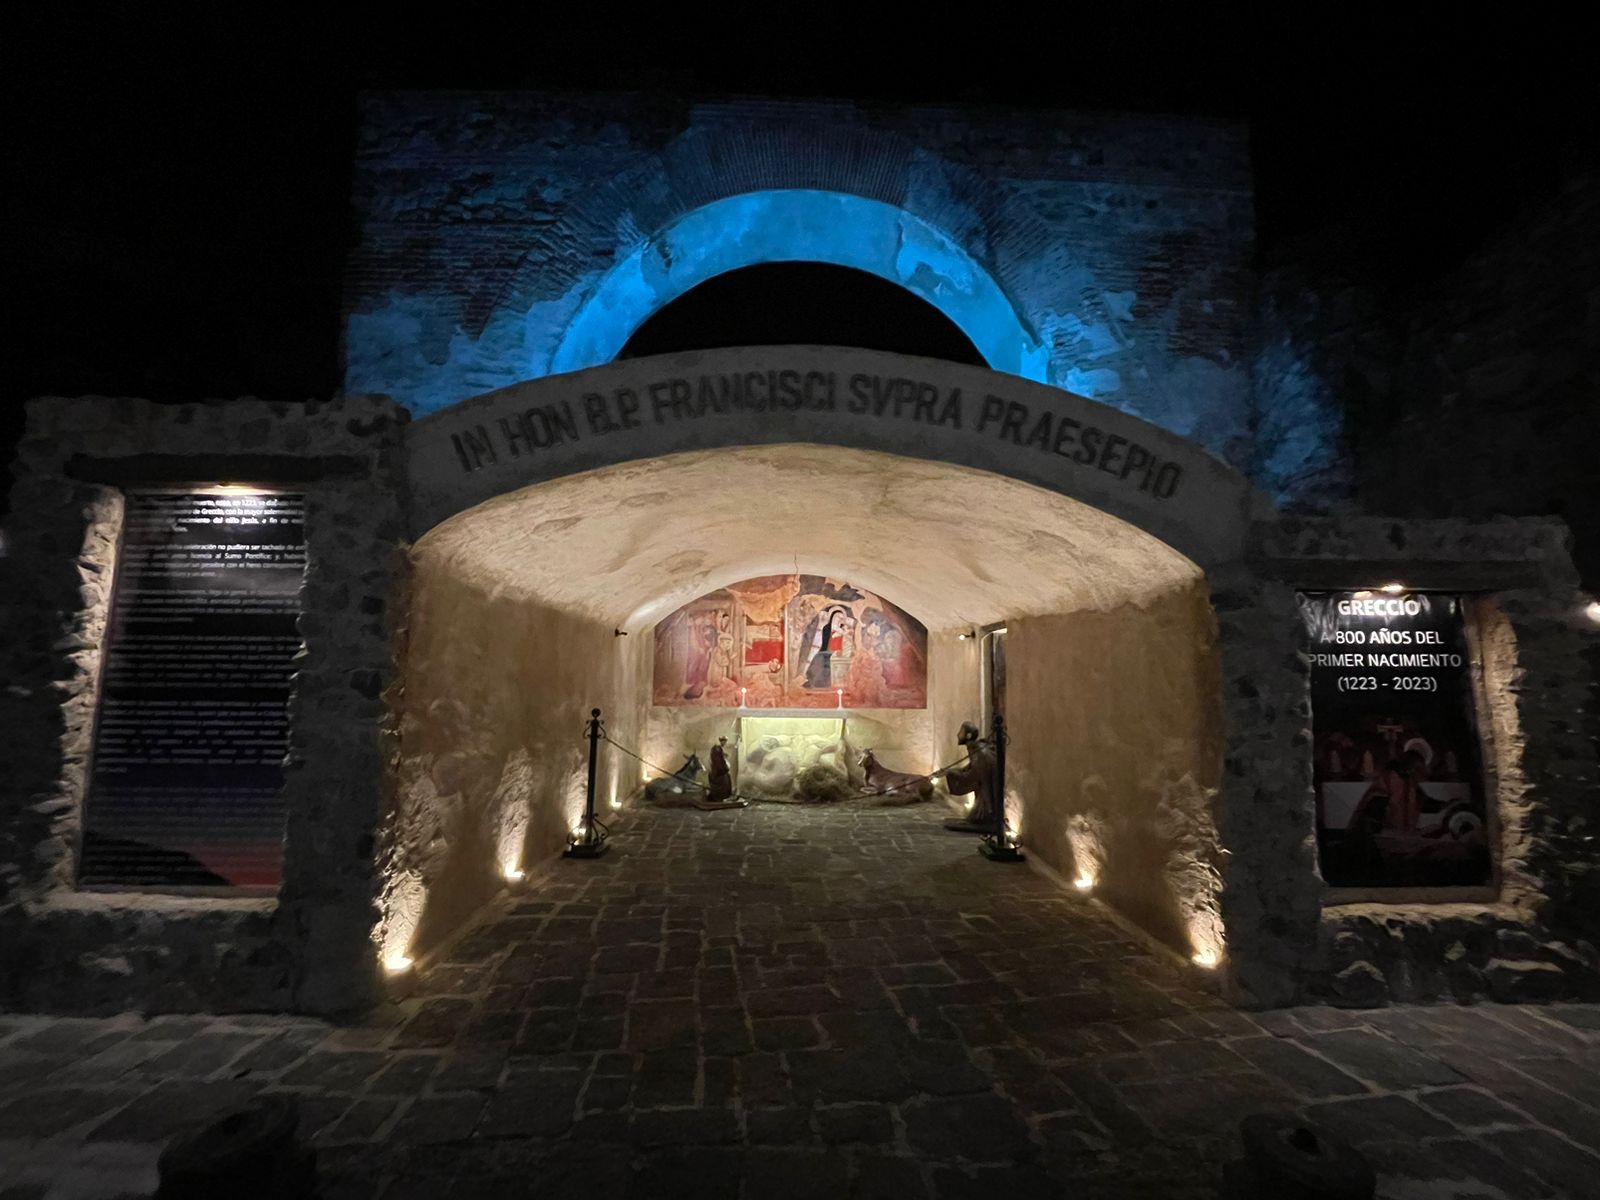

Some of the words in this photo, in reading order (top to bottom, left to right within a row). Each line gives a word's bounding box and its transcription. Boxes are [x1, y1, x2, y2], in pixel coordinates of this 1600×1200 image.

[451, 424, 498, 473] IN
[498, 401, 580, 459] HON
[648, 370, 835, 425] FRANCISCI
[850, 373, 963, 430] SVPRA
[976, 394, 1184, 500] PRAESEPIO
[1338, 600, 1420, 616] GRECCIO
[1336, 631, 1365, 644] 800
[1369, 628, 1412, 644] AÑOS
[1415, 631, 1444, 644] DEL
[1309, 653, 1364, 667] PRIMER
[1368, 653, 1462, 667] NACIMIENTO
[1337, 676, 1377, 692] (1223
[1393, 676, 1438, 692] 2023)
